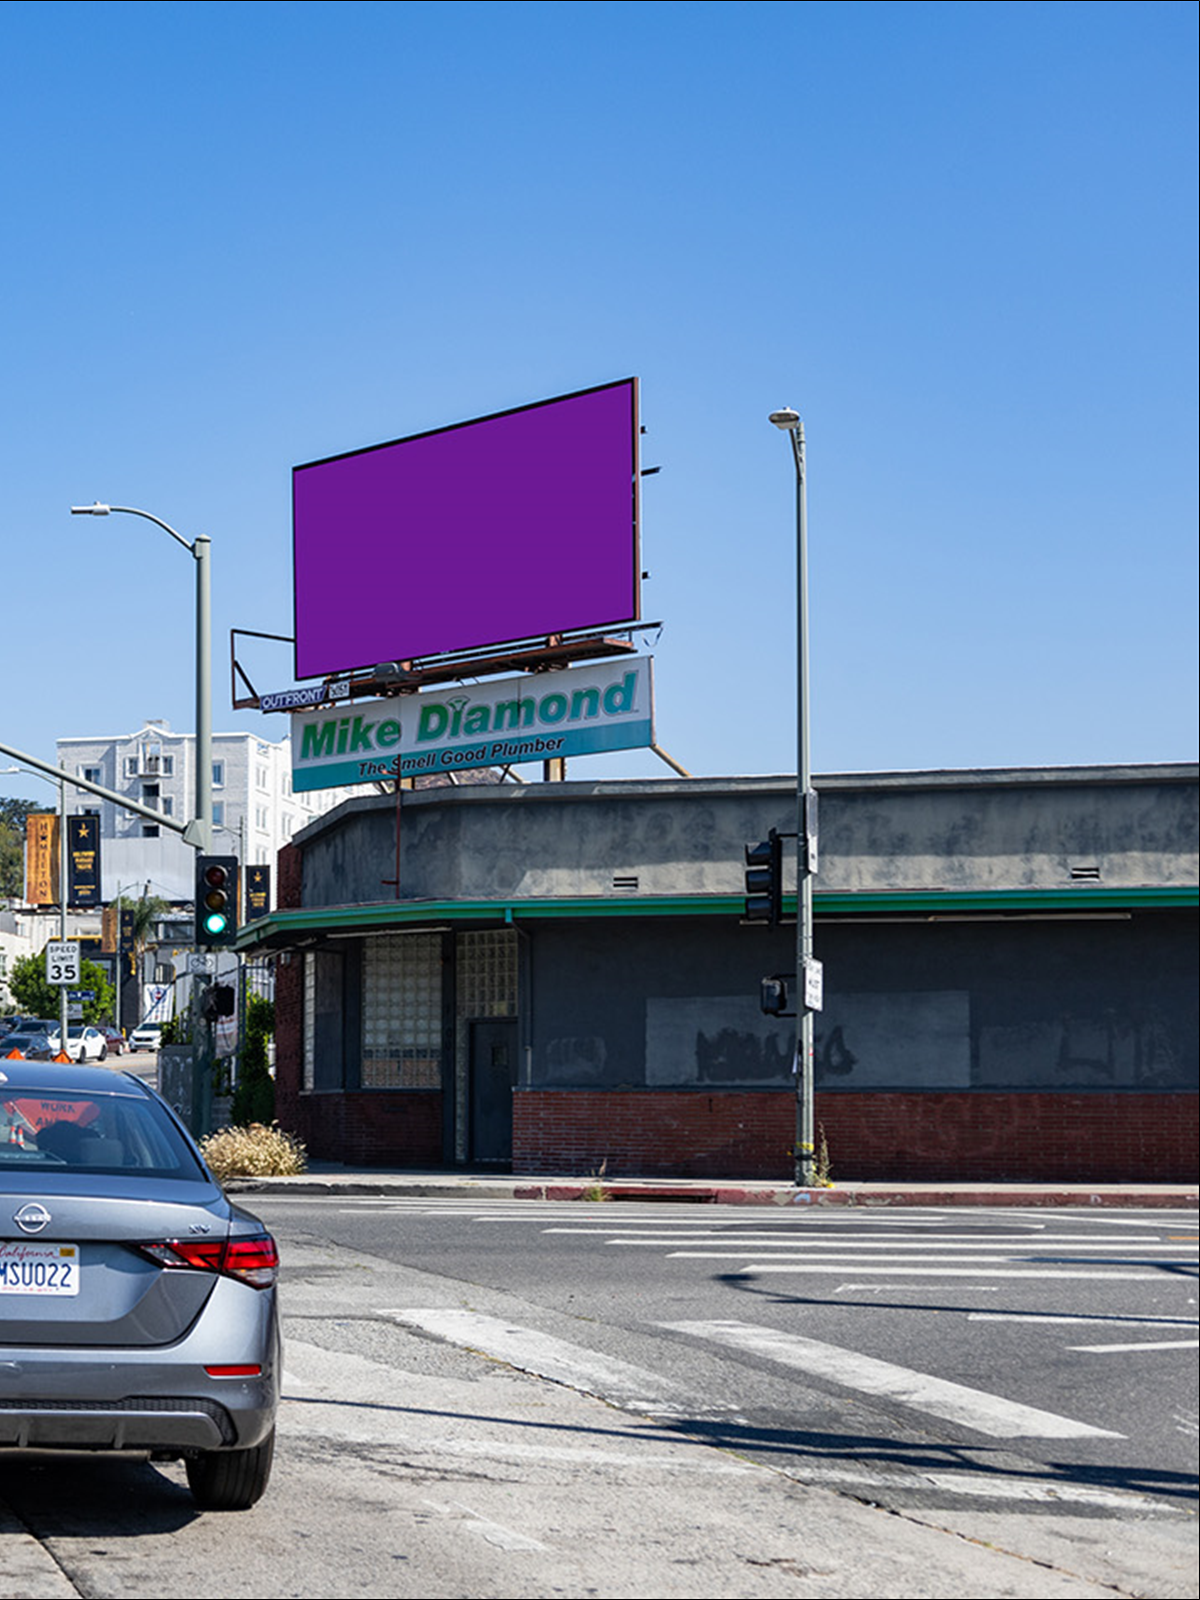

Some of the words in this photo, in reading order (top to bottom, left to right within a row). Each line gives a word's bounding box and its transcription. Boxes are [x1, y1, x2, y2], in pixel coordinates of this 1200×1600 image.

[263, 686, 323, 709] OUTFRONT
[299, 715, 402, 761] Mike
[416, 670, 638, 744] Diamond
[358, 762, 391, 777] The
[390, 751, 437, 773] Smell
[440, 744, 486, 765] Good
[491, 736, 566, 758] Plumber
[49, 945, 77, 953] SPEED
[51, 954, 75, 963] LIMIT
[51, 964, 77, 981] 35
